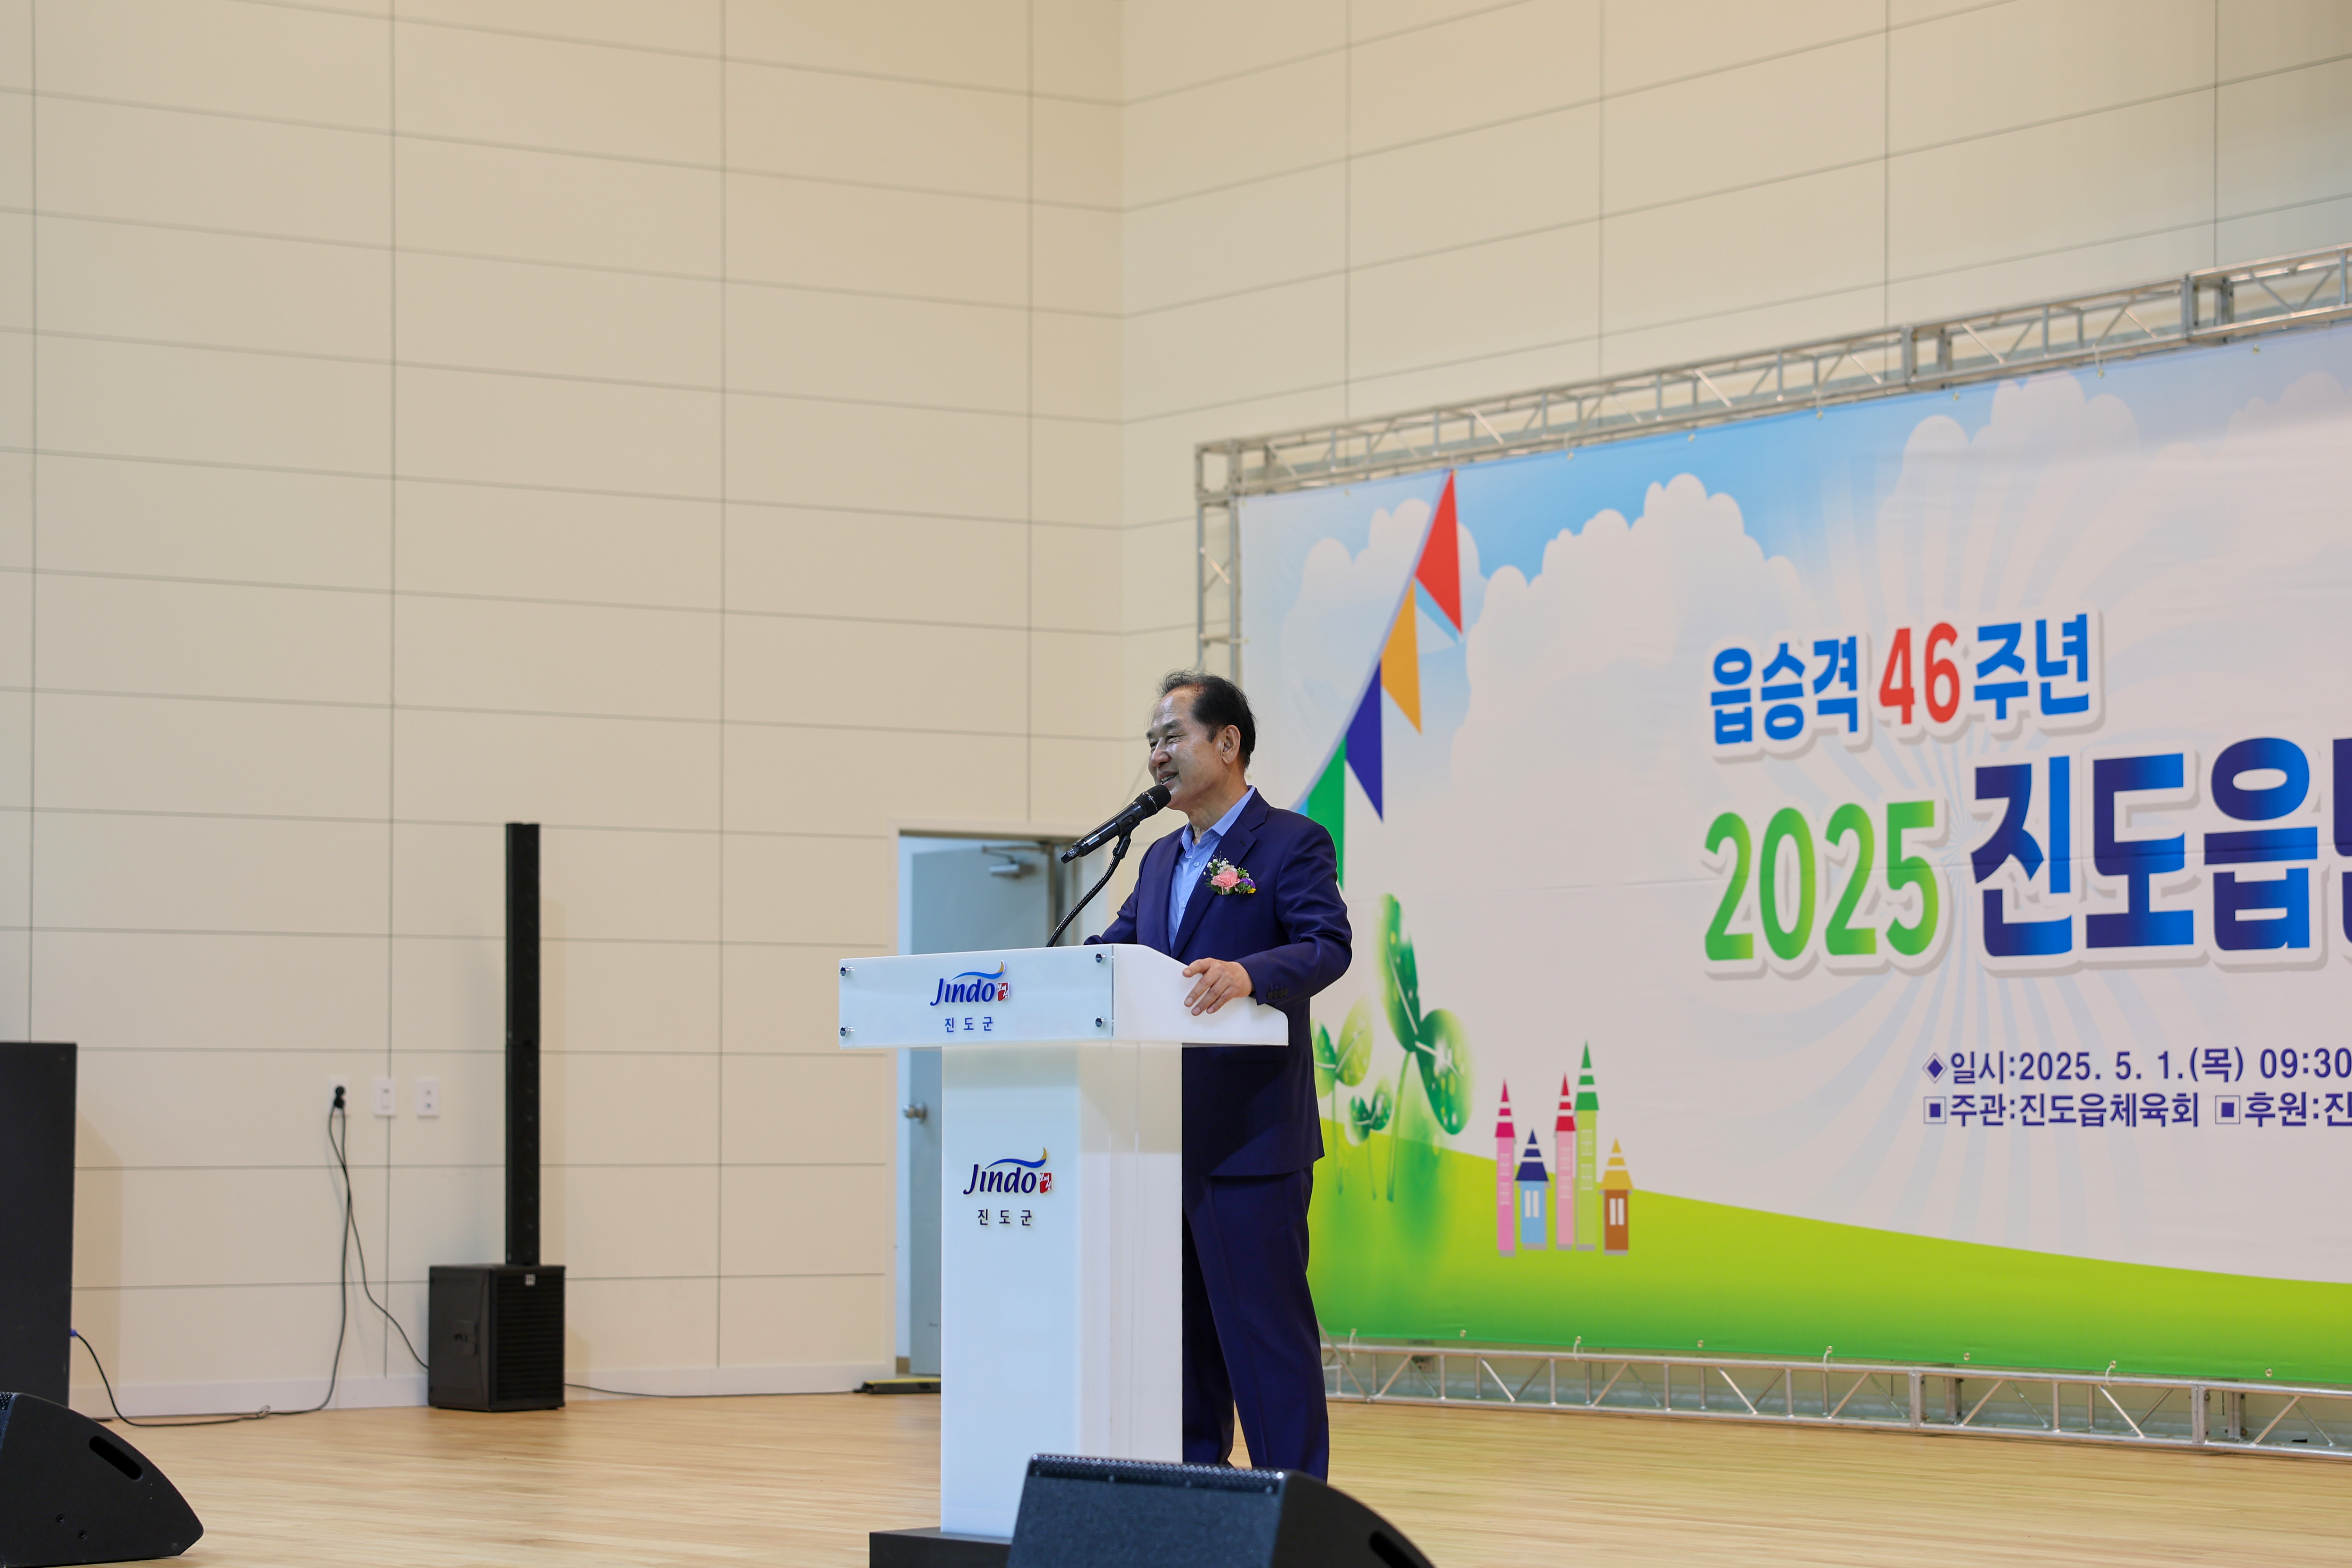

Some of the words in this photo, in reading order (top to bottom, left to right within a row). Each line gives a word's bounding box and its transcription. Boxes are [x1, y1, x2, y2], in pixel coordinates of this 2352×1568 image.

[1711, 636, 1858, 745] 읍승격
[1705, 800, 1939, 961] 2025
[930, 978, 995, 1006] Jindo
[2115, 1051, 2141, 1080] 5.
[963, 1164, 1037, 1195] Jindo
